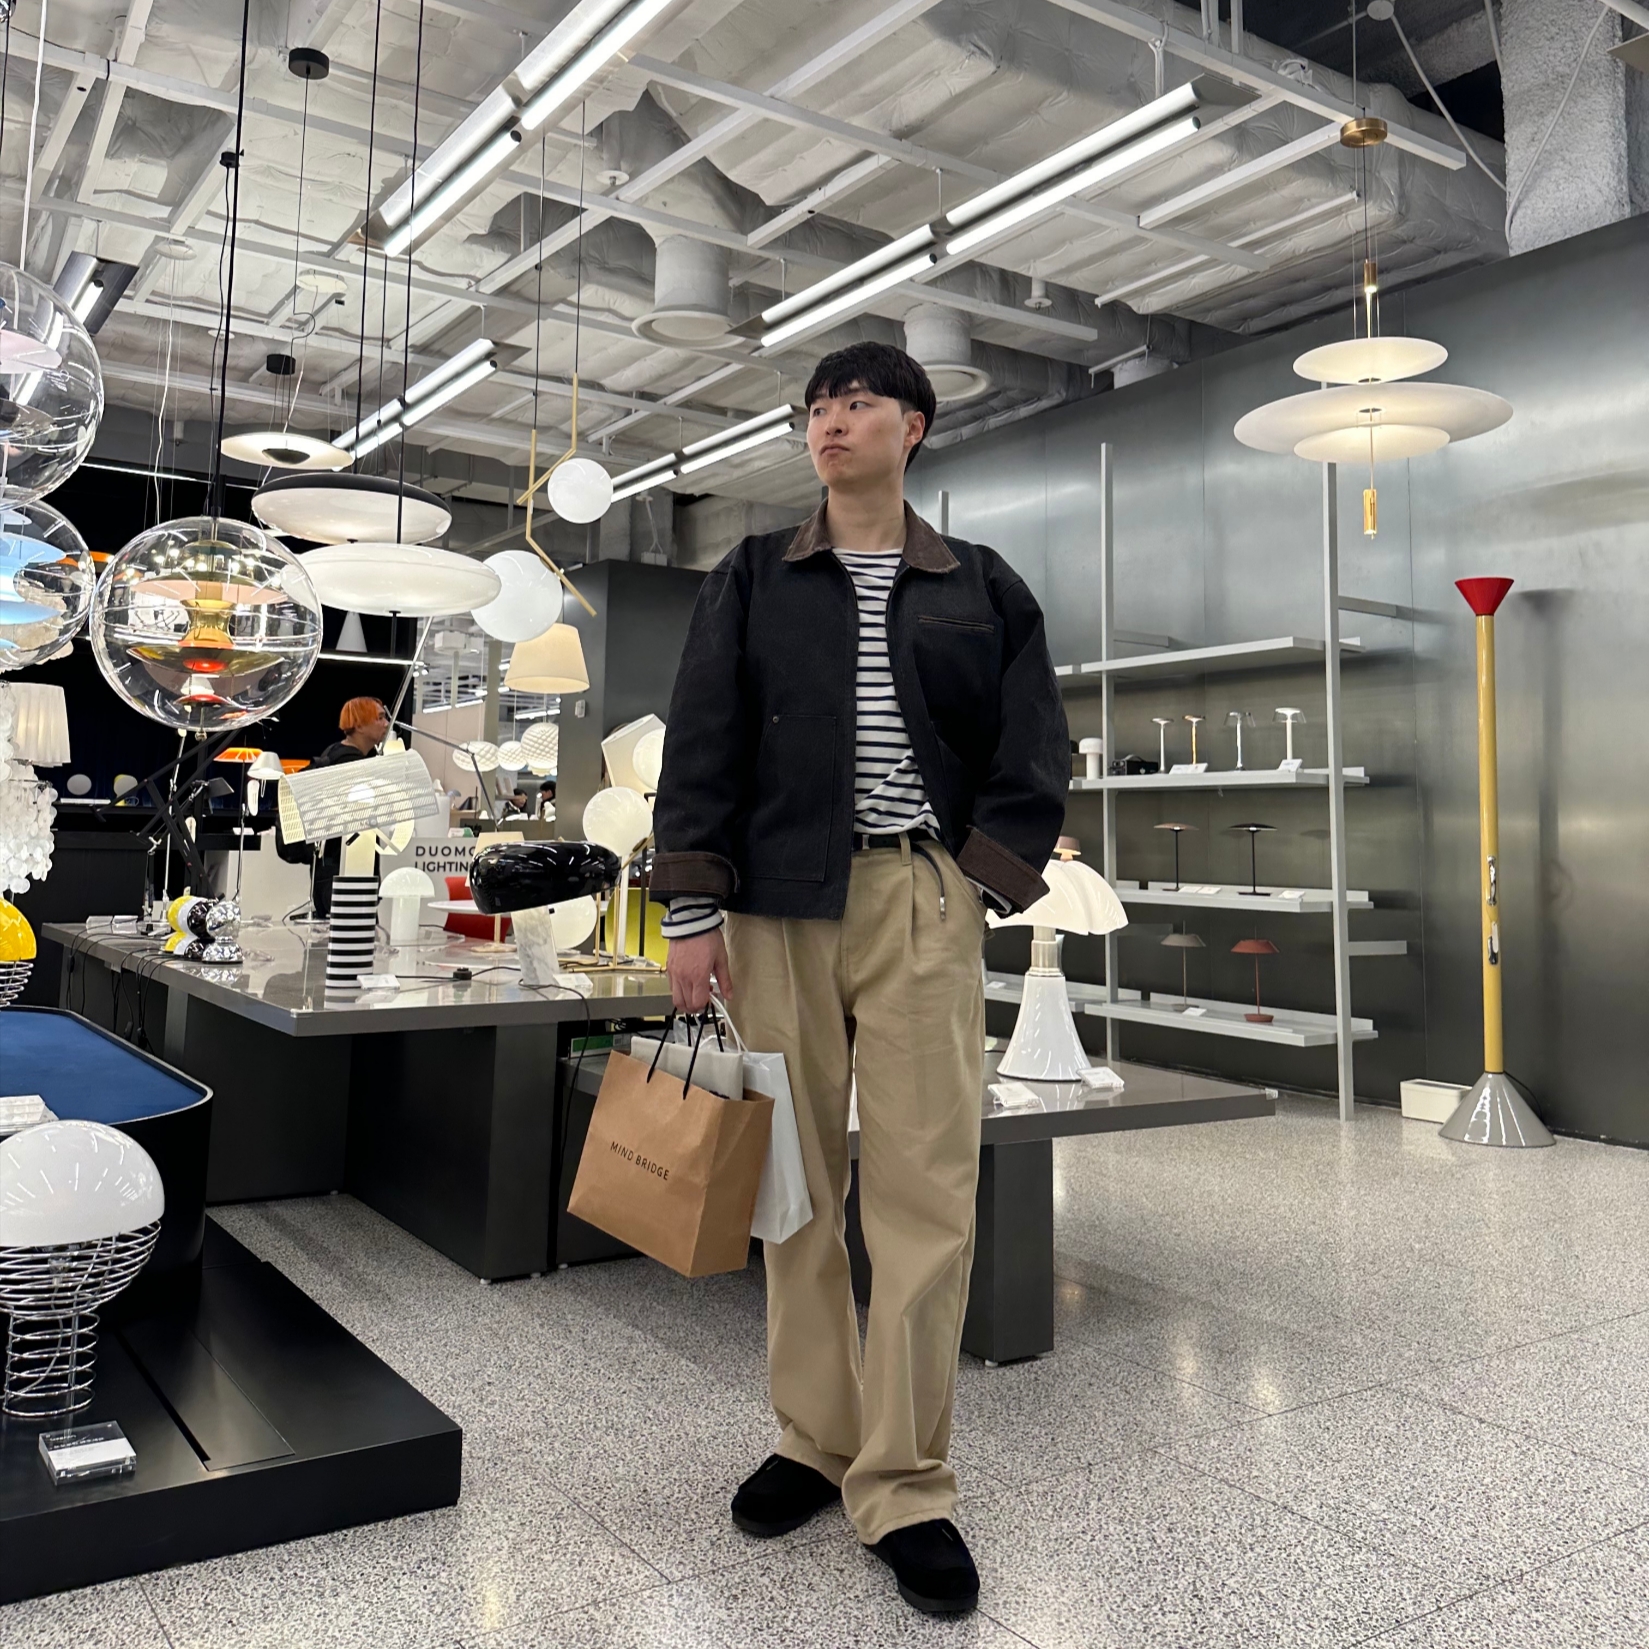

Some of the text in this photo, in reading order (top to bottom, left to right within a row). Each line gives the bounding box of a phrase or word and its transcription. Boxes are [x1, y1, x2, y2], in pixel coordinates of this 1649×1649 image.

[415, 861, 469, 872] IGHTIN
[610, 1141, 670, 1181] MIND BRIDGE
